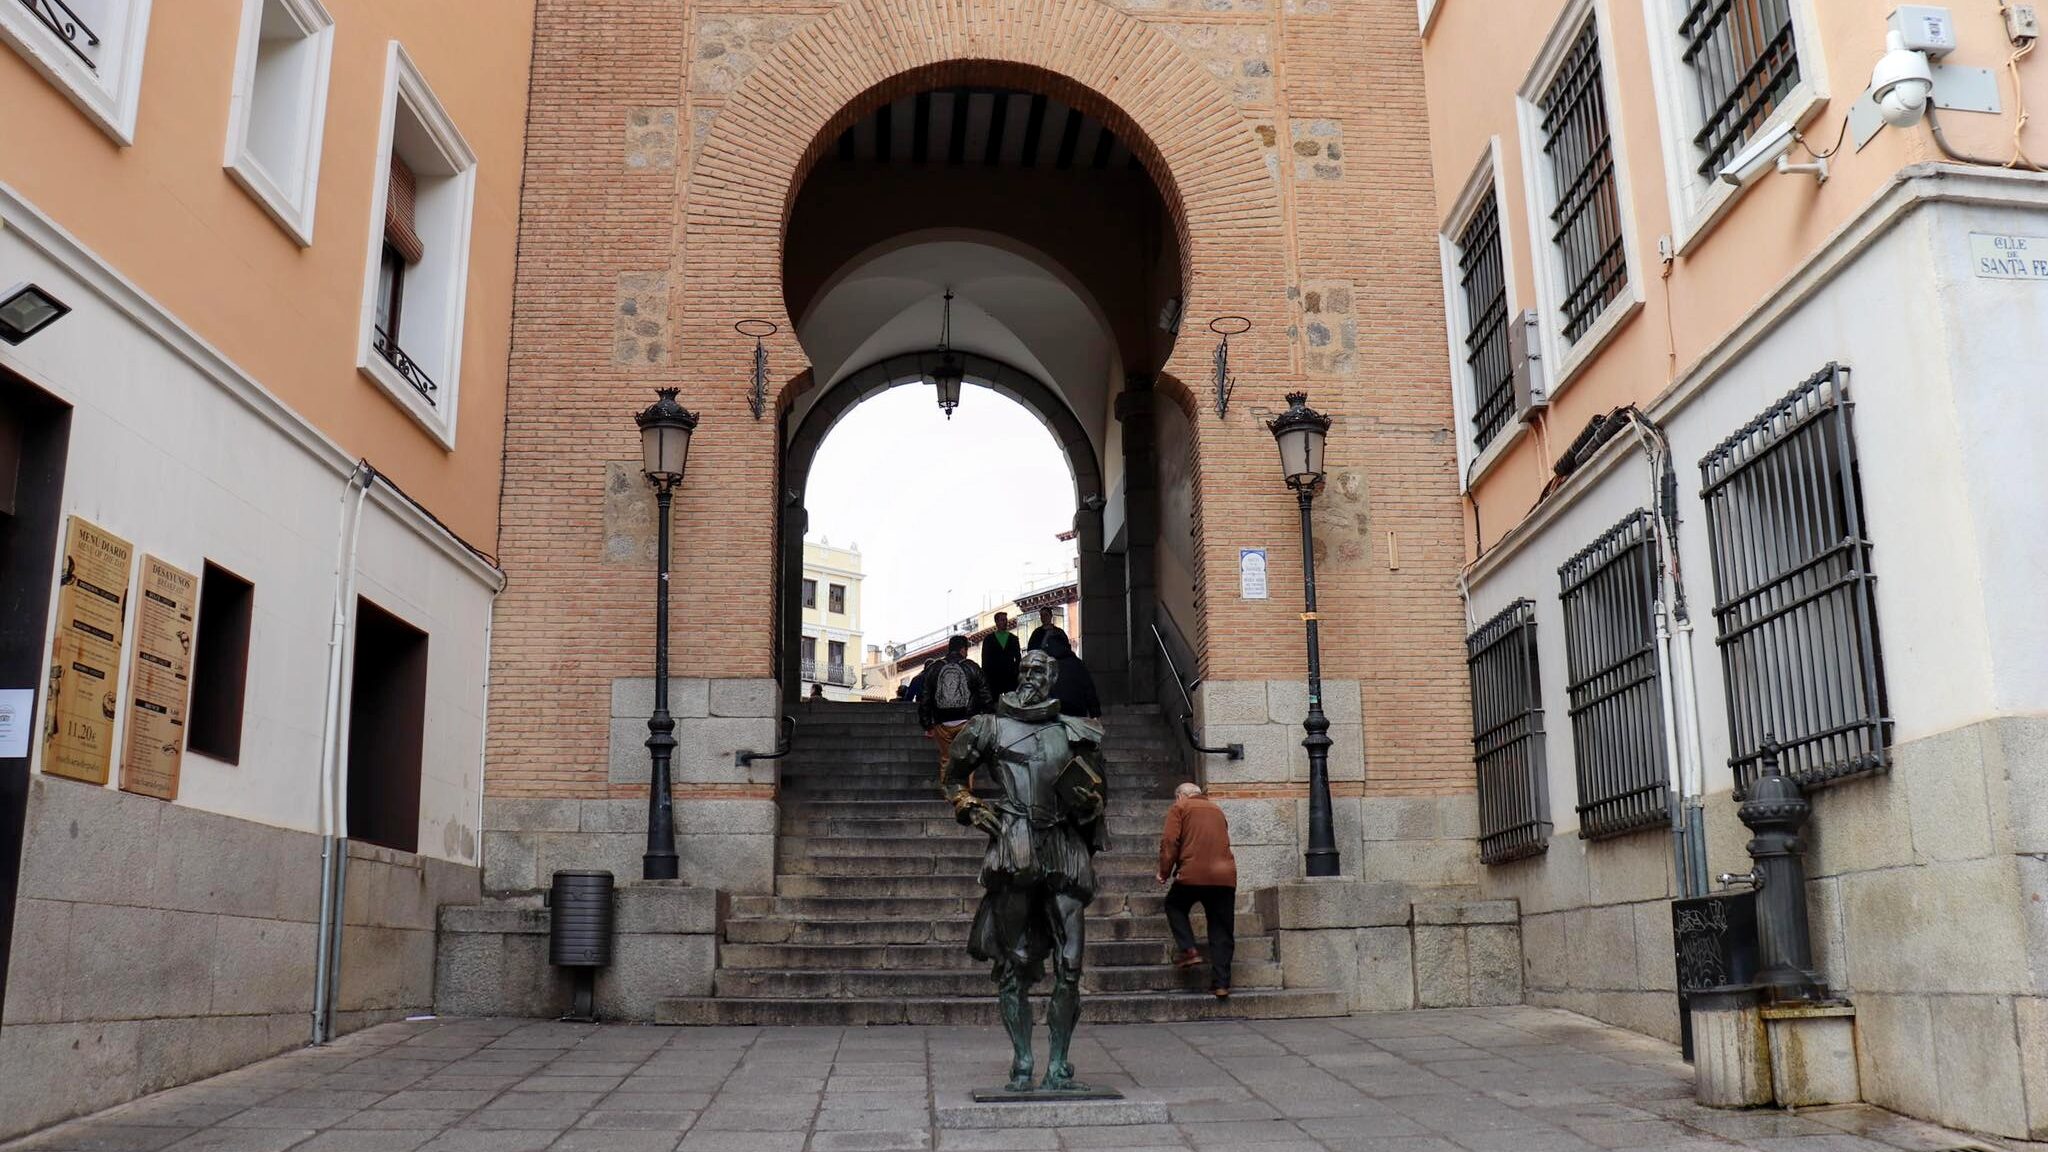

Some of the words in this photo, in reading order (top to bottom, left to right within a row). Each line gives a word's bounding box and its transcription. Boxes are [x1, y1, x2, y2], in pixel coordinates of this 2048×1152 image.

[1981, 257, 2028, 275] SANTA
[2032, 259, 2048, 276] FE
[101, 540, 127, 560] DIARIO
[152, 564, 190, 589] DESAYUNOS
